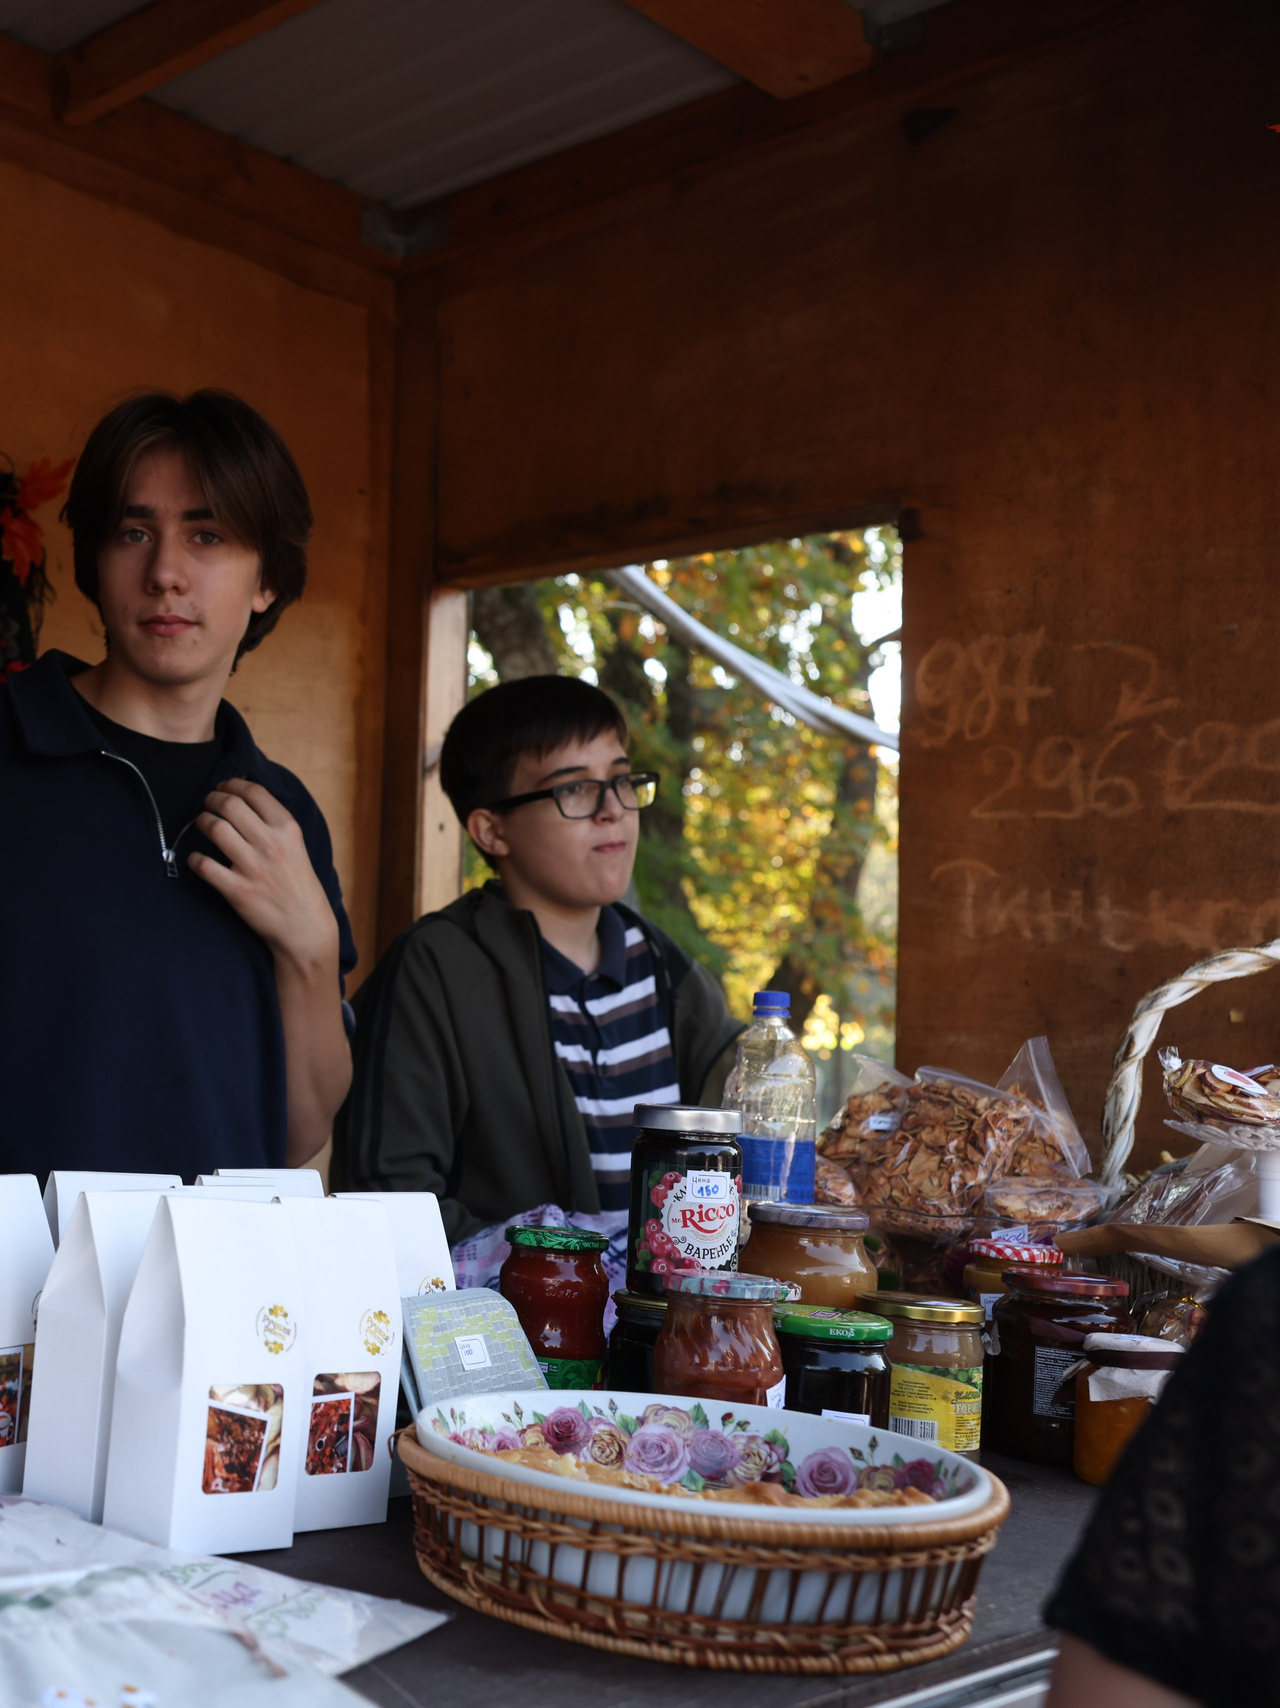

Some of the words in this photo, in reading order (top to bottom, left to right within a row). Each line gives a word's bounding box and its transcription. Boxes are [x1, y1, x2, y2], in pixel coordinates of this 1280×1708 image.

[697, 1184, 719, 1197] 150
[680, 1203, 735, 1232] Ricco
[683, 1236, 734, 1260] ВАРЕНЬЕ
